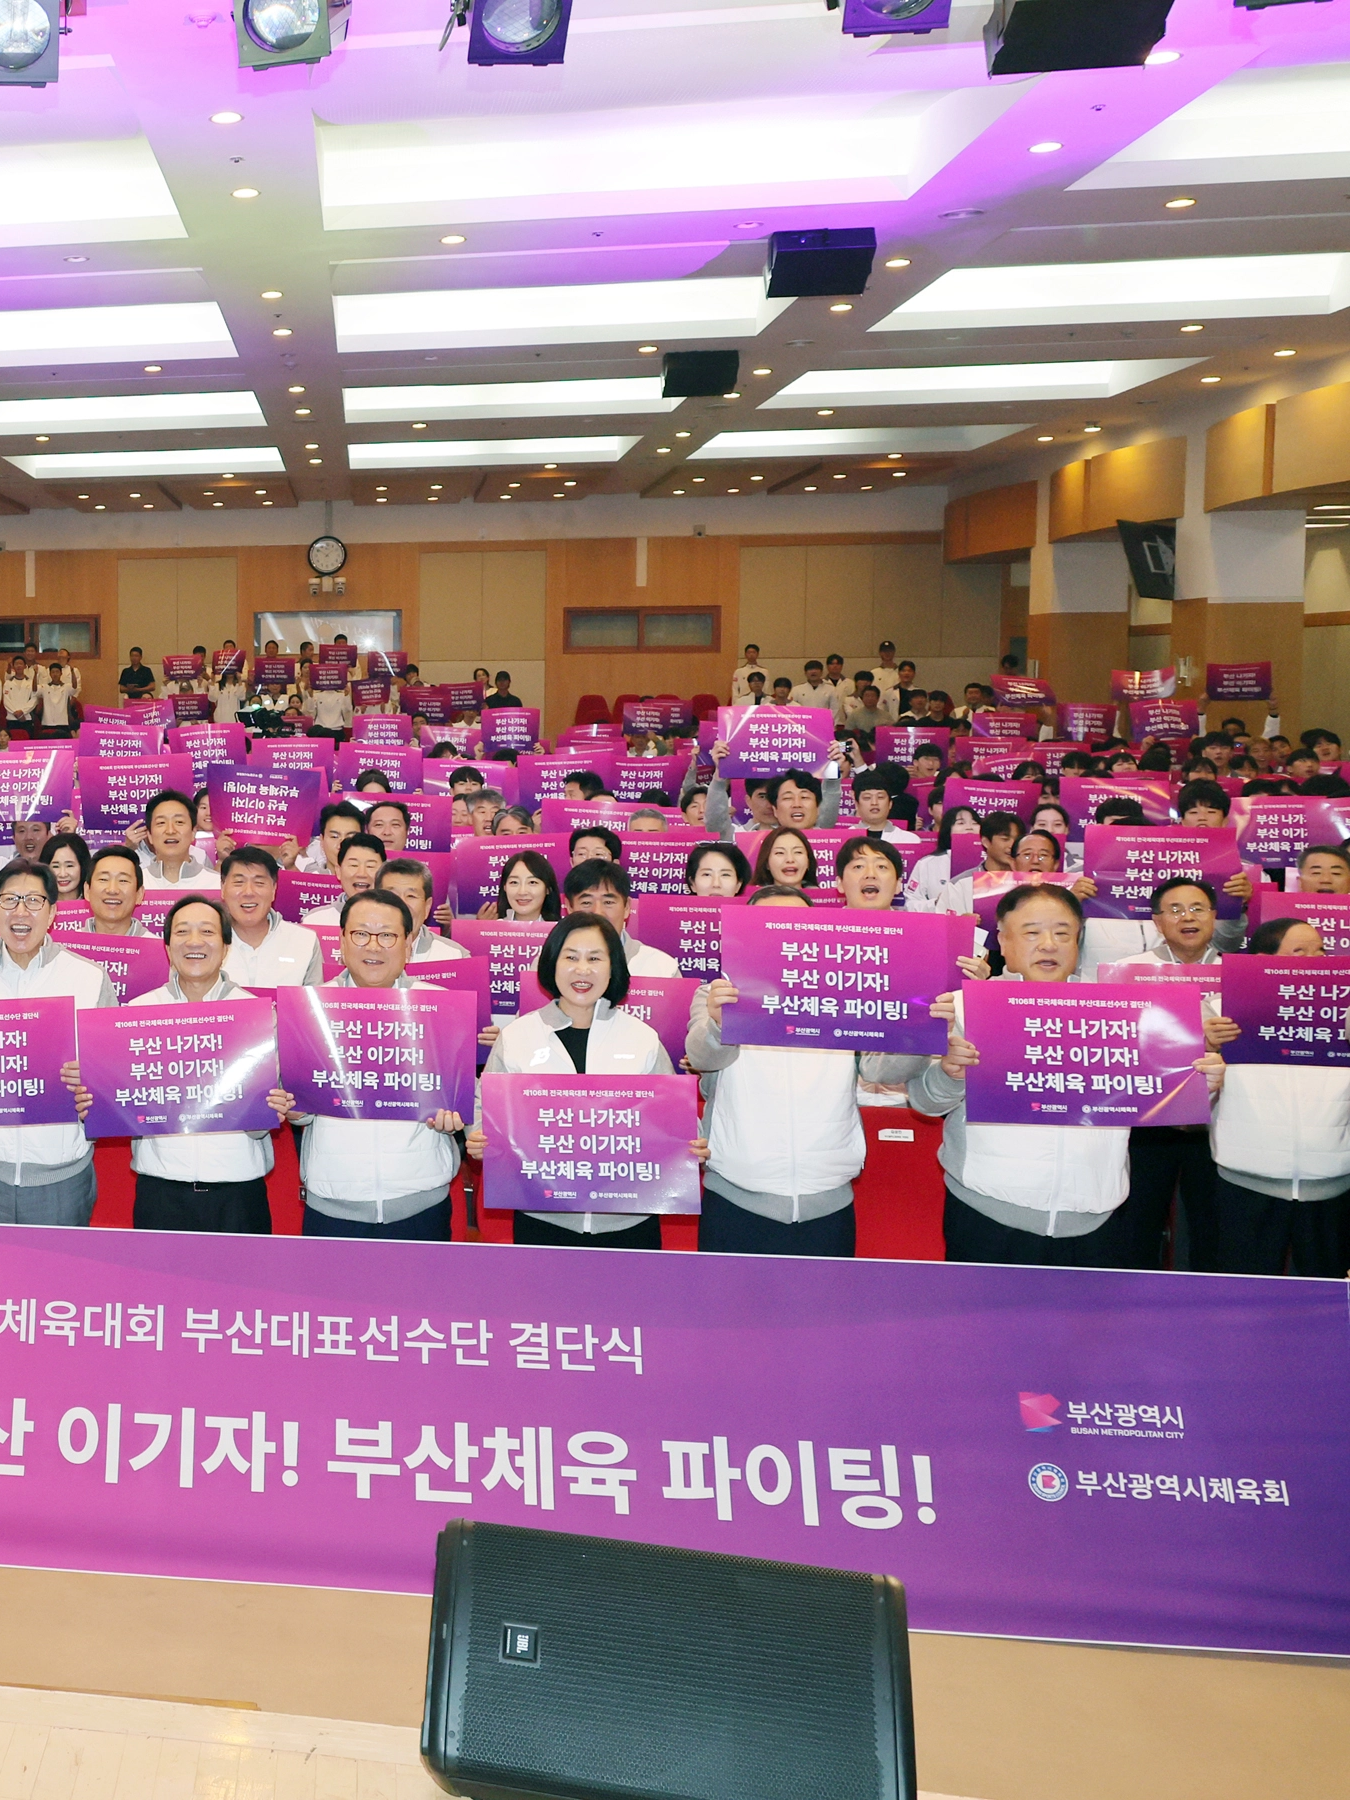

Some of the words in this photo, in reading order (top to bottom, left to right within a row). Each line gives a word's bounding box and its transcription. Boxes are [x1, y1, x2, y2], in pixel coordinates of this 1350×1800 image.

[749, 724, 769, 734] 부산
[772, 723, 806, 734] 나가자!
[749, 737, 769, 748] 부산
[772, 737, 806, 748] 이기자!
[739, 751, 780, 763] 부산체육
[781, 751, 816, 763] 파이팅!
[780, 942, 820, 962] 부산
[825, 943, 889, 966] 나가자!
[781, 968, 820, 989] 부산
[825, 970, 889, 993] 이기자!
[1278, 984, 1316, 1000] 부산
[762, 995, 839, 1018] 부산체육
[844, 998, 908, 1021] 파이팅!
[1277, 1006, 1315, 1021] 부산
[330, 1020, 363, 1038] 부산
[367, 1020, 424, 1040] 나가자!
[1023, 1017, 1063, 1038] 부산
[1068, 1018, 1137, 1040] 나가자!
[1258, 1026, 1332, 1043] 부산체육
[129, 1036, 163, 1056] 부산
[166, 1033, 223, 1054] 나가자!
[367, 1046, 424, 1066] 이기자!
[1024, 1045, 1064, 1065] 부산
[1070, 1046, 1139, 1067] 이기자!
[130, 1061, 164, 1081] 부산
[168, 1058, 223, 1079] 이기자!
[312, 1070, 380, 1090] 부산체육
[384, 1072, 441, 1091] 파이팅!
[1005, 1072, 1086, 1094] 부산체육
[1091, 1074, 1163, 1095] 파이팅!
[115, 1086, 182, 1106] 부산체육
[537, 1108, 574, 1127] 부산
[579, 1108, 640, 1128] 나가자!
[538, 1134, 574, 1154] 부산
[580, 1134, 641, 1154] 이기자!
[520, 1160, 594, 1180] 부산체육
[598, 1161, 660, 1182] 파이팅!
[182, 1308, 493, 1366] 부산대표선수단
[509, 1323, 642, 1374] 결단식
[1066, 1401, 1185, 1429] 부산광역시
[1070, 1426, 1099, 1436] BUSAN
[1100, 1428, 1164, 1438] METROPOLITAN
[1165, 1431, 1184, 1439] CITY
[58, 1404, 298, 1492] 이기자!
[328, 1419, 636, 1514] 부산체육
[662, 1436, 936, 1529] 파이팅!
[1076, 1470, 1290, 1506] 부산광역시체육회
[516, 1634, 529, 1654] JBL
